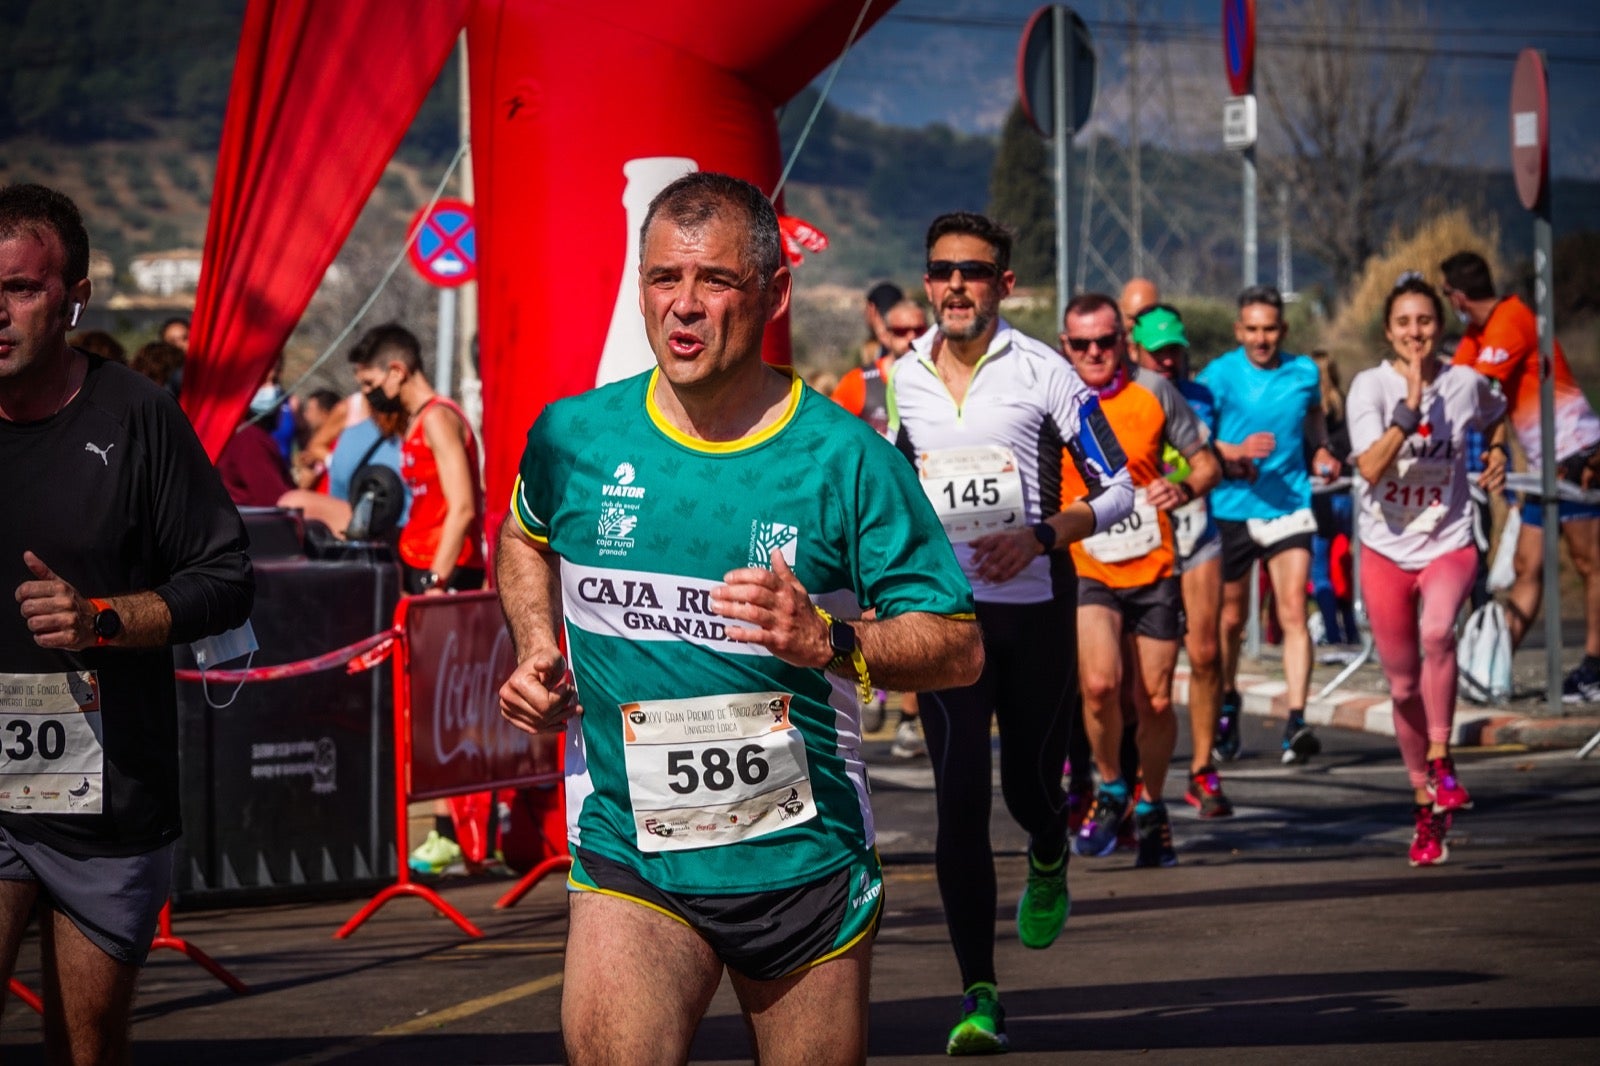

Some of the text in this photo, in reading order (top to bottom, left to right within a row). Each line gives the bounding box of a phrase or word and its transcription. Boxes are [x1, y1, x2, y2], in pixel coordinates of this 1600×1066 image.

[602, 485, 645, 499] VIATOR
[943, 478, 1000, 509] 145
[1384, 481, 1441, 507] 2113
[597, 538, 634, 548] caja rural
[599, 548, 627, 556] granada
[578, 577, 663, 609] CAJA
[0, 719, 66, 761] 30
[667, 744, 769, 795] 586
